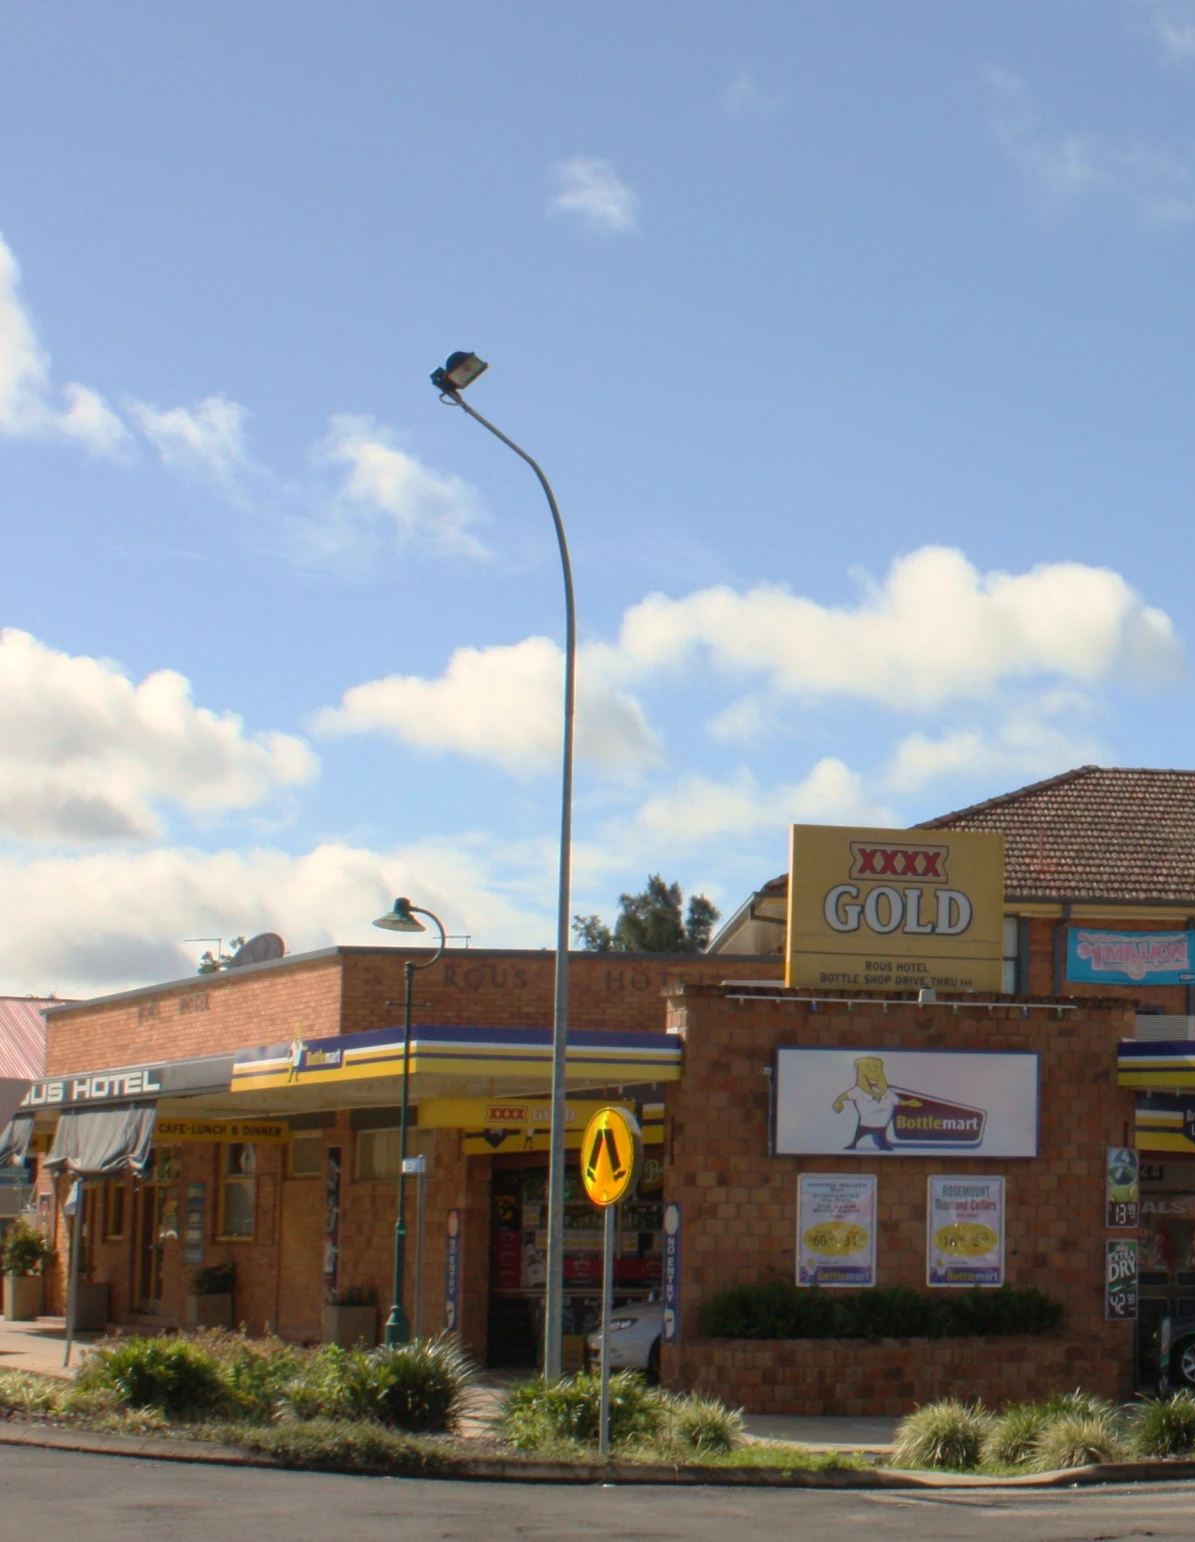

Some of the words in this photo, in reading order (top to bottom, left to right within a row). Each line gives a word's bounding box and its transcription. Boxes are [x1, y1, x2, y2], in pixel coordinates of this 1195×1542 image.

[857, 848, 941, 877] XXXX
[824, 884, 972, 935] GOLD
[1104, 941, 1188, 963] MILLION
[865, 961, 893, 972] ROUS
[896, 962, 929, 973] HOTEL
[443, 964, 529, 989] ROUS
[819, 973, 860, 984] BOTTLE
[864, 974, 891, 985] SHOP
[895, 975, 926, 986] DRIVE
[930, 977, 958, 987] THRU
[73, 1070, 160, 1100] HOTEL
[490, 1107, 526, 1120] XXXX
[532, 1107, 576, 1122] GOD
[158, 1122, 227, 1136] CAFE-LUNCH
[243, 1125, 282, 1138] DINNER
[896, 1115, 979, 1131] Bottlemart
[942, 1185, 990, 1198] ROSEMOUNT
[935, 1198, 968, 1211] Diaond
[970, 1199, 997, 1211] Cellars
[667, 1237, 675, 1254] NO
[1108, 1249, 1135, 1264] EXTRA
[818, 1271, 872, 1281] Bottlemart
[1108, 1257, 1136, 1282] DRY
[666, 1260, 675, 1302] ENTRY
